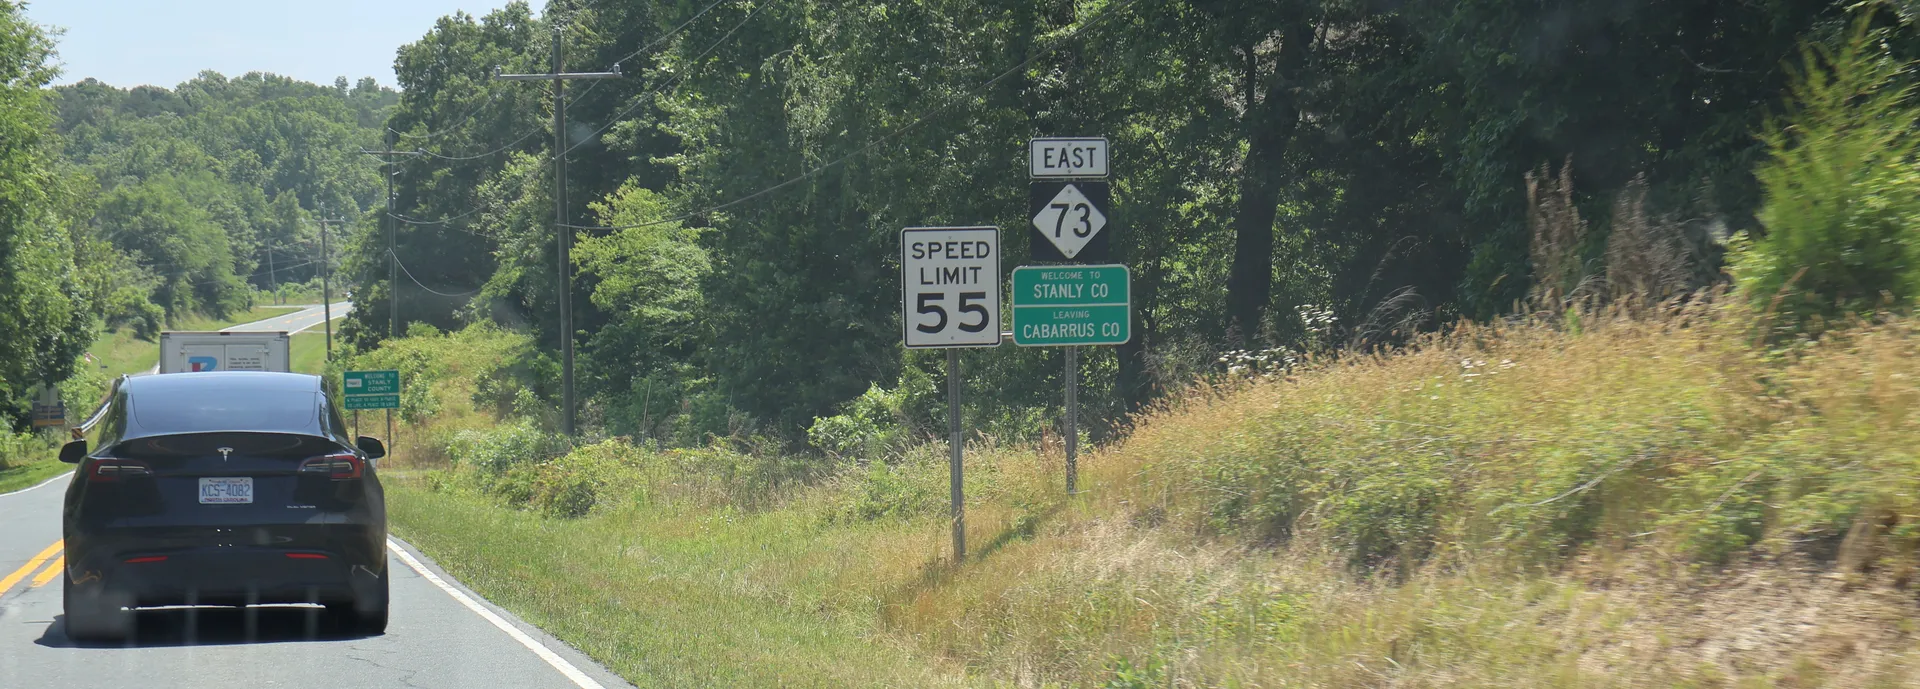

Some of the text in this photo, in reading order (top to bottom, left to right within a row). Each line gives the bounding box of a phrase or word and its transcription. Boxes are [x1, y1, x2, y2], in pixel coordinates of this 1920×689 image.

[1044, 147, 1097, 168] EAST
[1050, 203, 1092, 238] 73
[911, 241, 991, 260] SPEED
[920, 266, 982, 286] LIMIT
[1041, 271, 1101, 280] WELCOME TO
[1033, 283, 1109, 299] STANLY CO
[915, 291, 990, 334] 55
[1053, 310, 1090, 319] LEAVING
[1023, 322, 1120, 339] CABARRUS CO
[201, 483, 250, 497] KCS-4082
